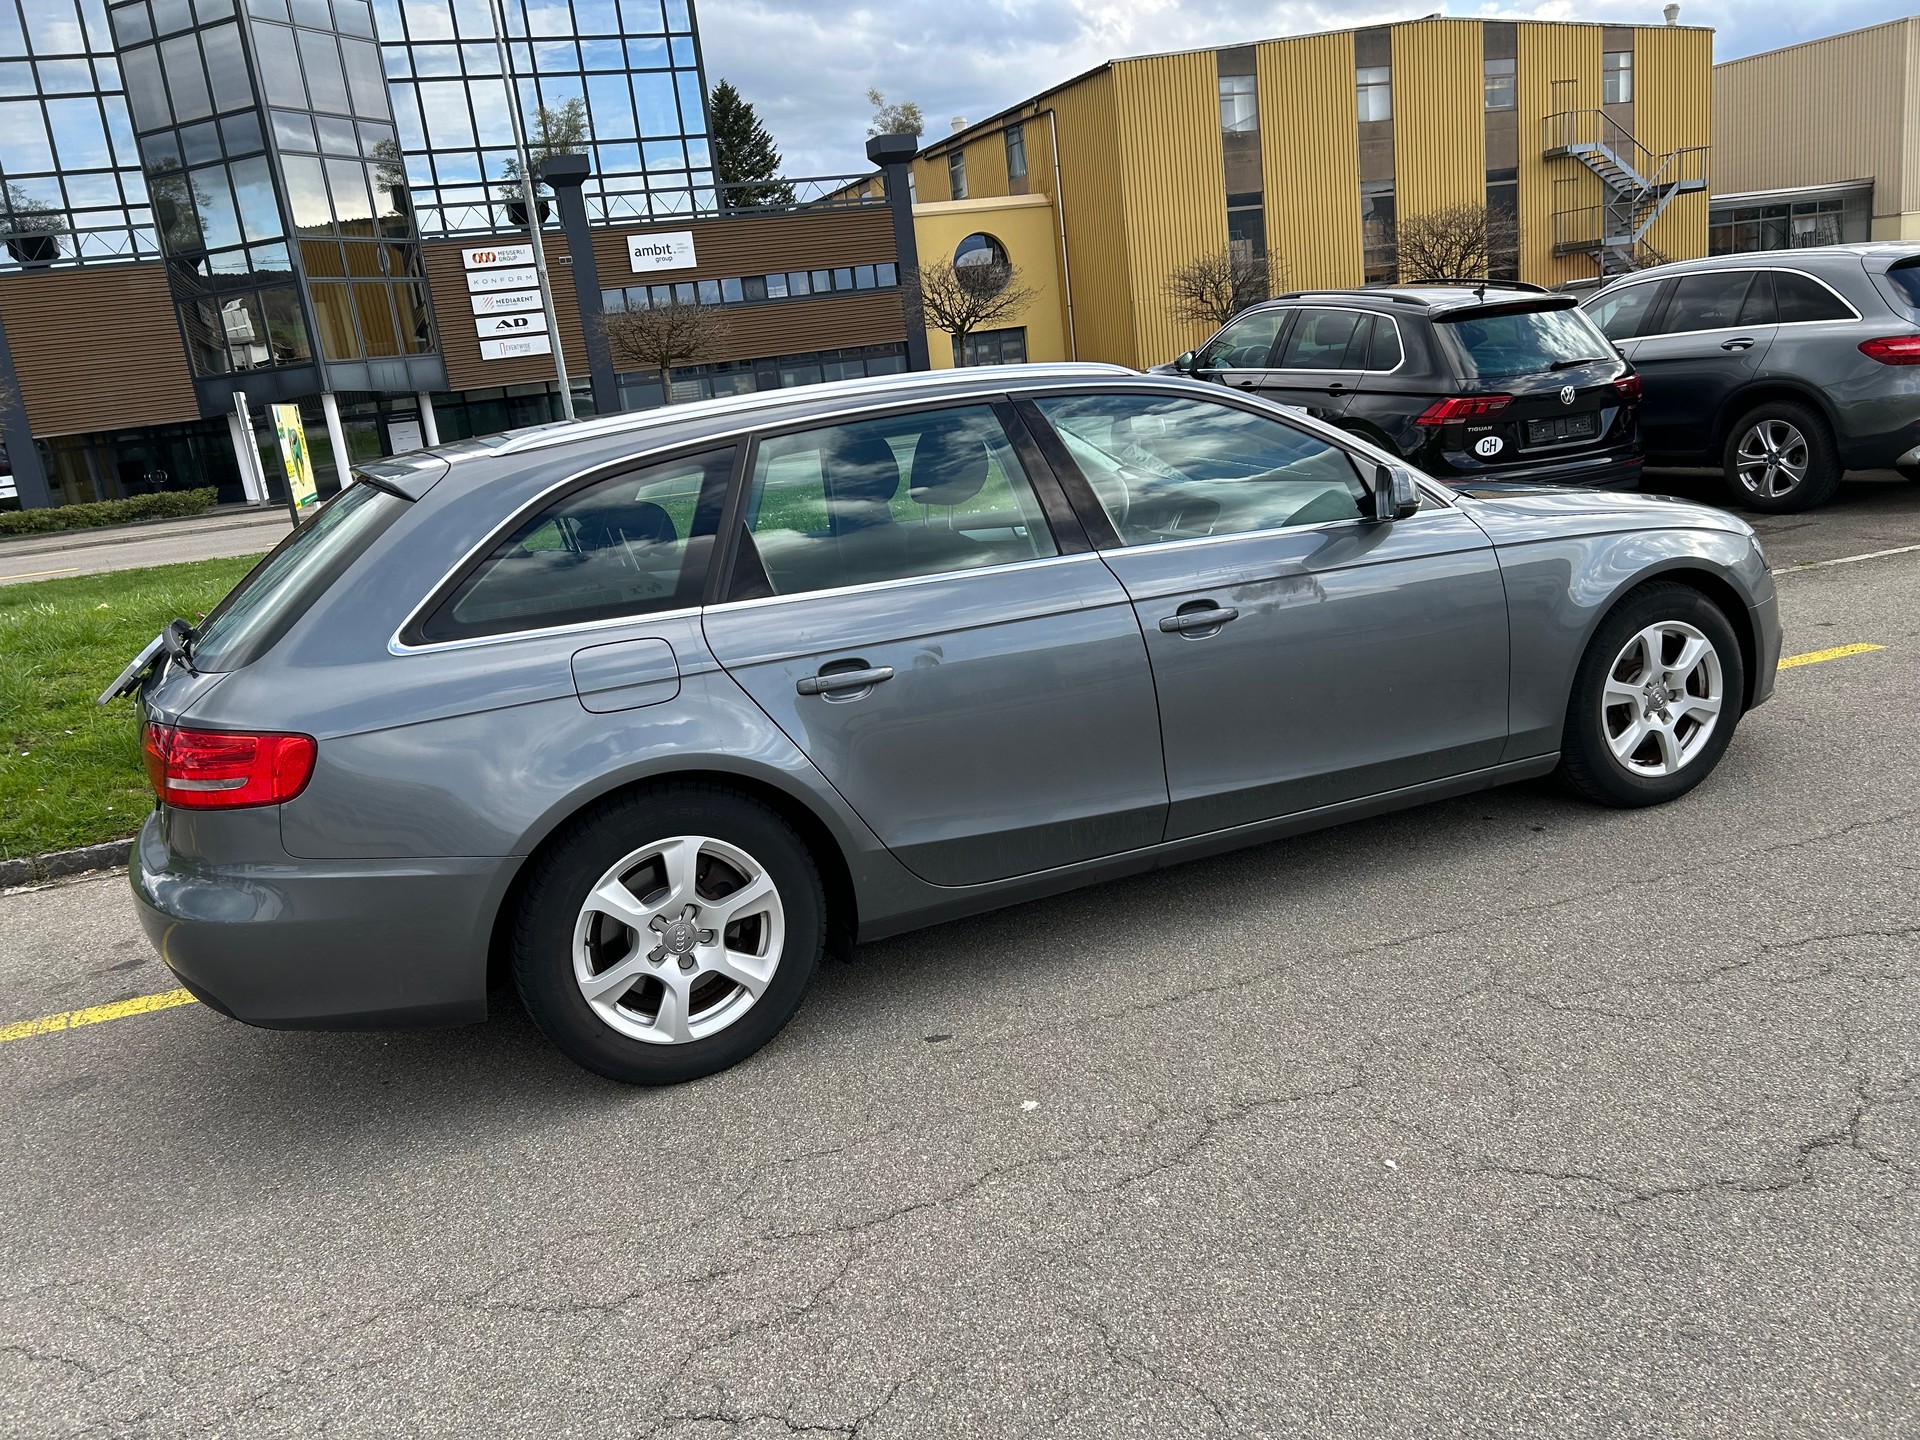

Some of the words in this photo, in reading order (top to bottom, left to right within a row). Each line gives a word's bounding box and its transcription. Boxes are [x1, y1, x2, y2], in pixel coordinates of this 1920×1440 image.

[655, 256, 673, 264] group
[473, 275, 532, 285] KONFORM
[495, 296, 533, 304] MEDIARENT
[495, 317, 528, 329] AD
[1467, 425, 1493, 433] TIGUAN
[1481, 438, 1497, 453] CH
